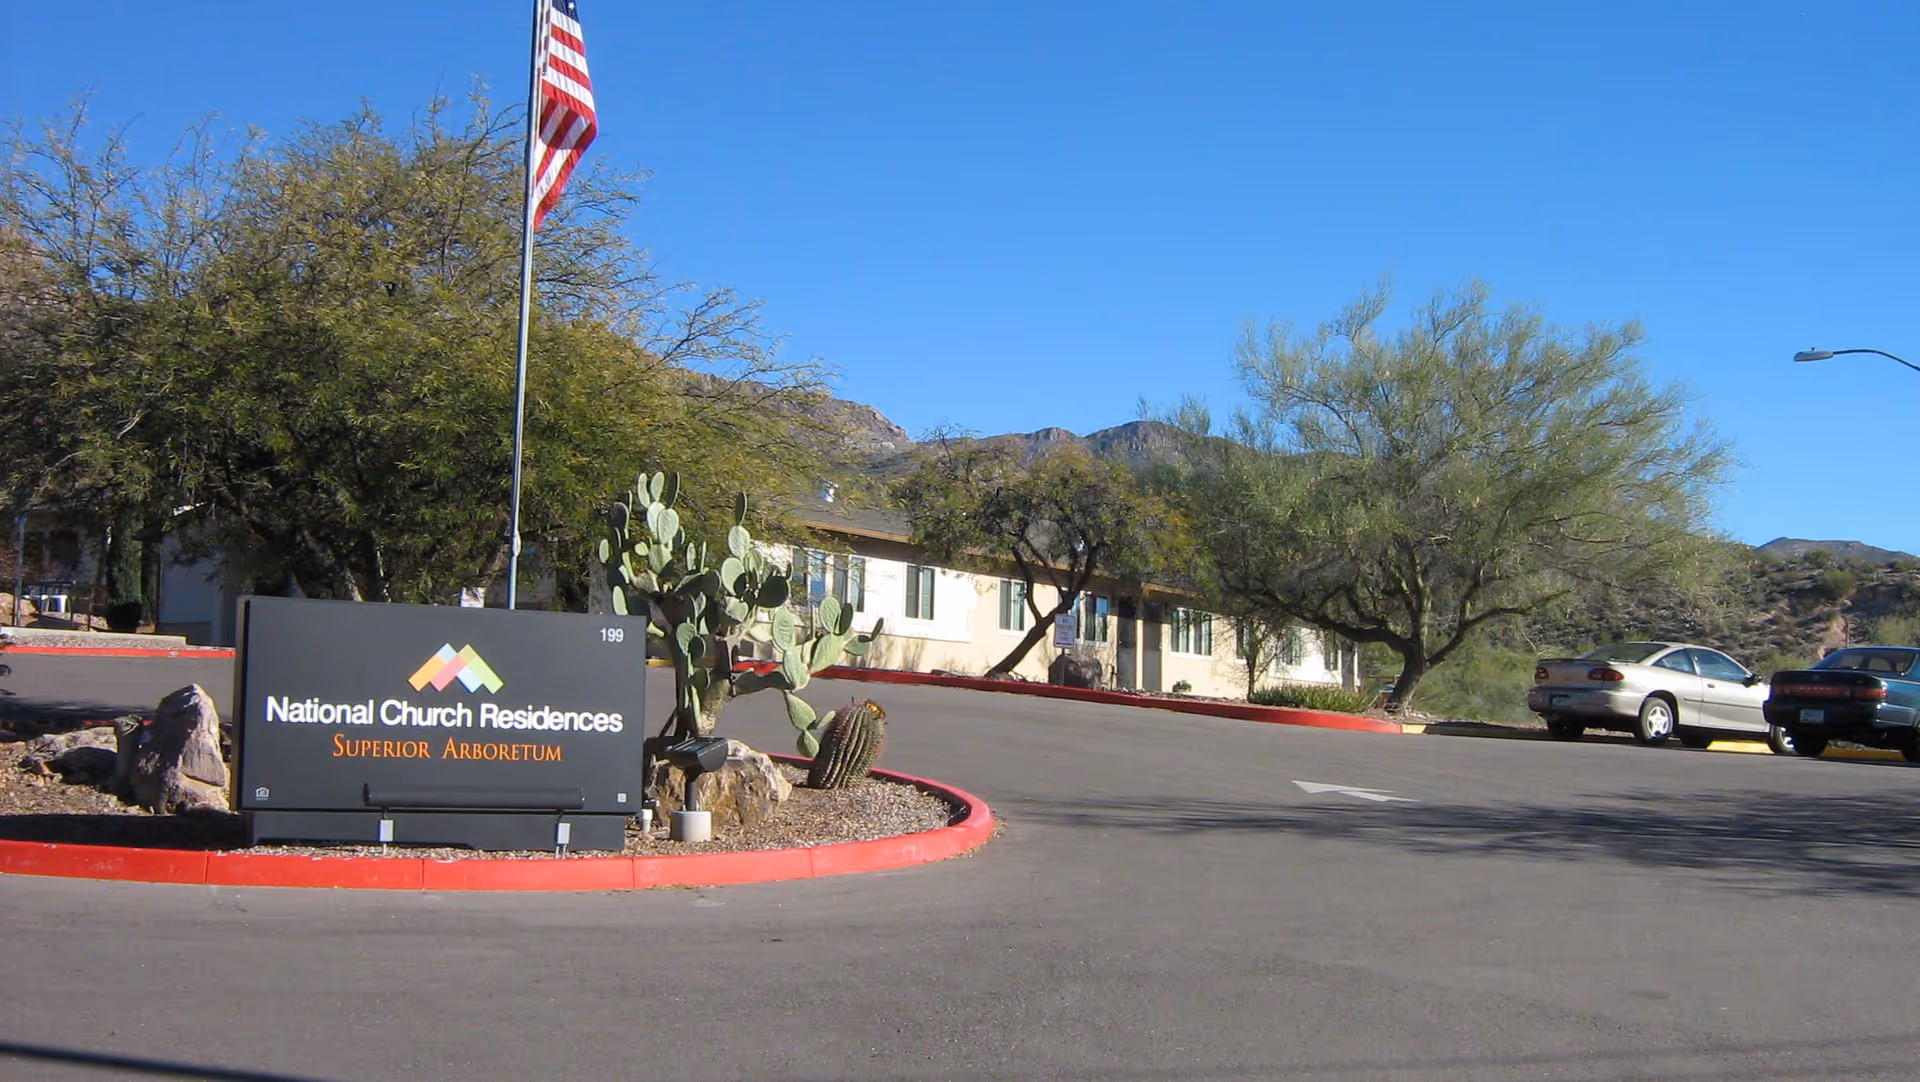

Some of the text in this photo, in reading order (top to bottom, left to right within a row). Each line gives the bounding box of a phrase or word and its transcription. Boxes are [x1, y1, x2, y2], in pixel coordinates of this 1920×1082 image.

[600, 628, 624, 643] 199
[265, 696, 623, 733] National Church Residences
[332, 733, 563, 763] SUPERIOR ARBORETUM
